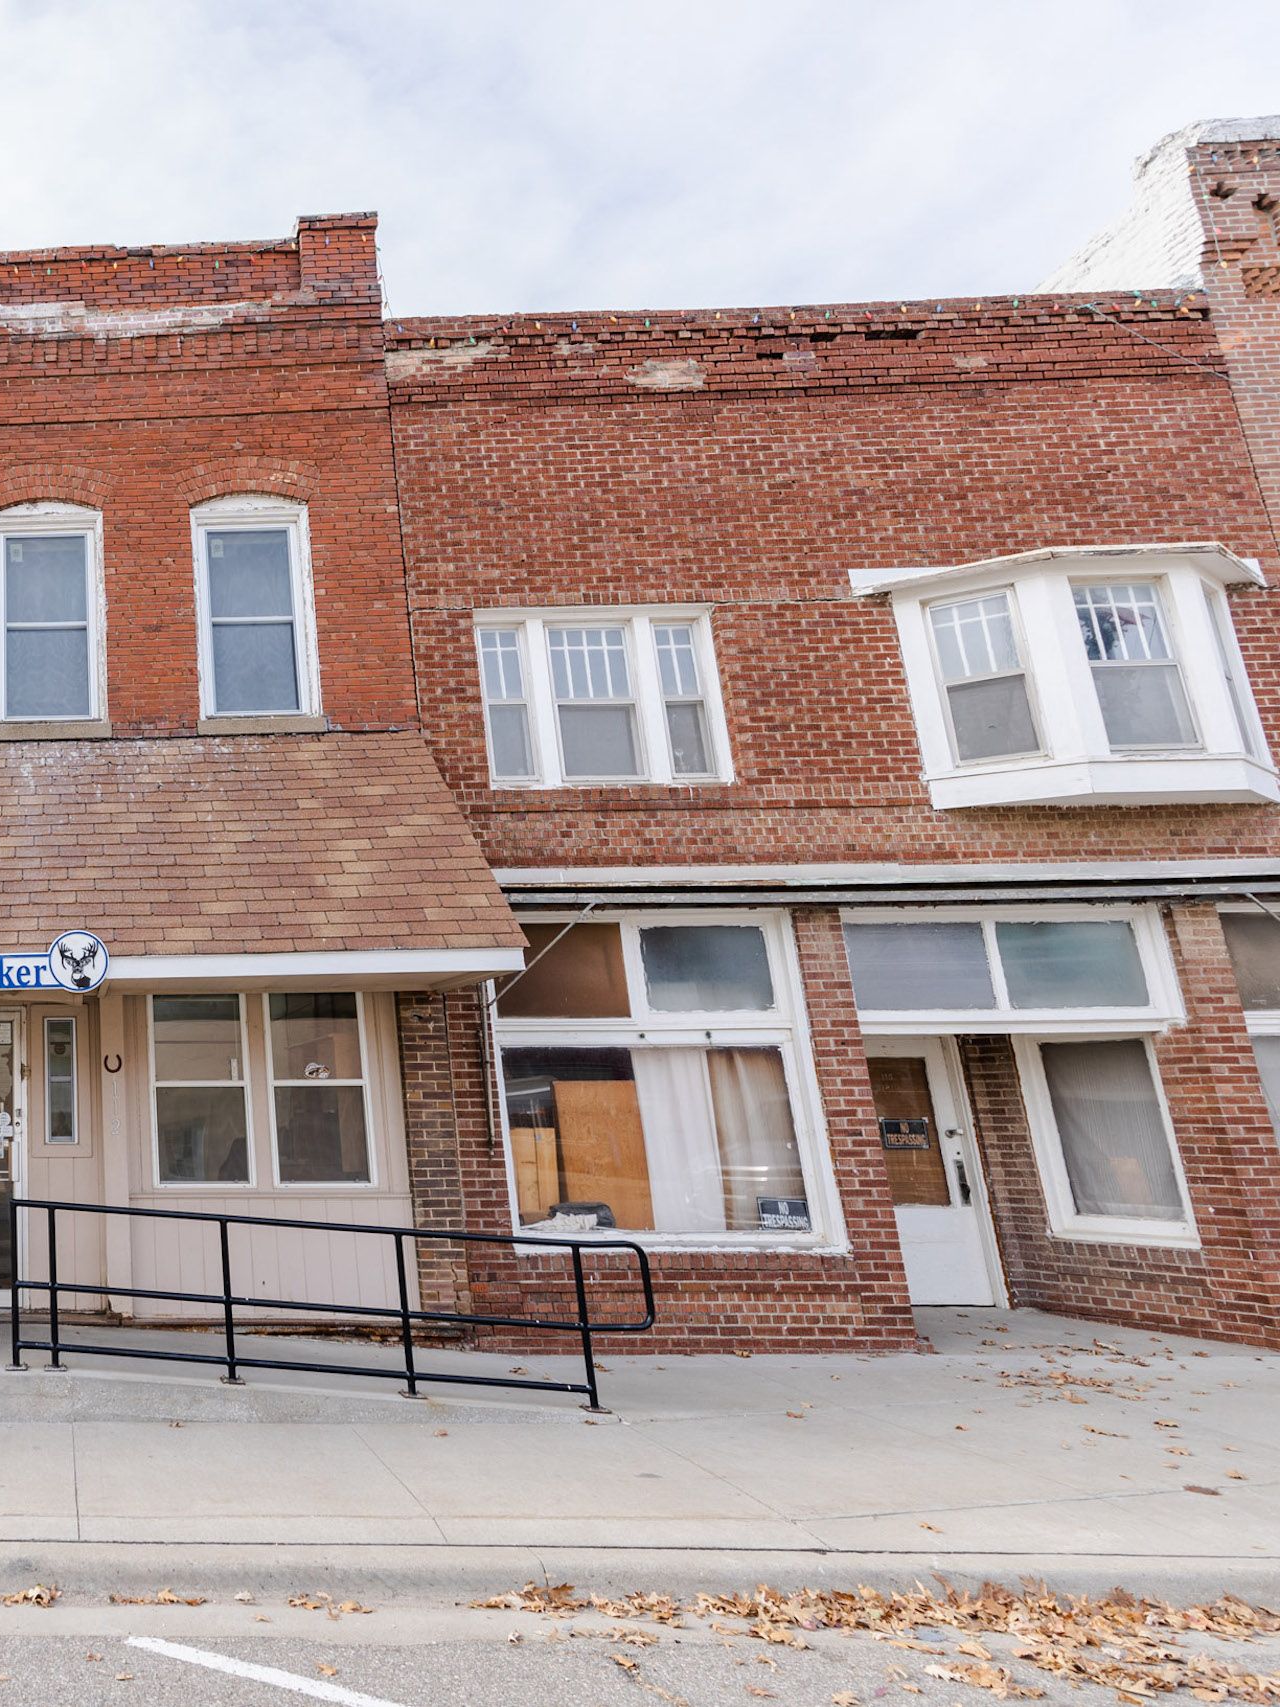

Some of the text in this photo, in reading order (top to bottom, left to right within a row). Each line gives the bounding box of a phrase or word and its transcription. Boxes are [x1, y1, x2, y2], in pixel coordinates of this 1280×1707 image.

[900, 1122, 910, 1134] NO
[777, 1200, 790, 1215] NO
[762, 1214, 809, 1229] TRESPASSING
